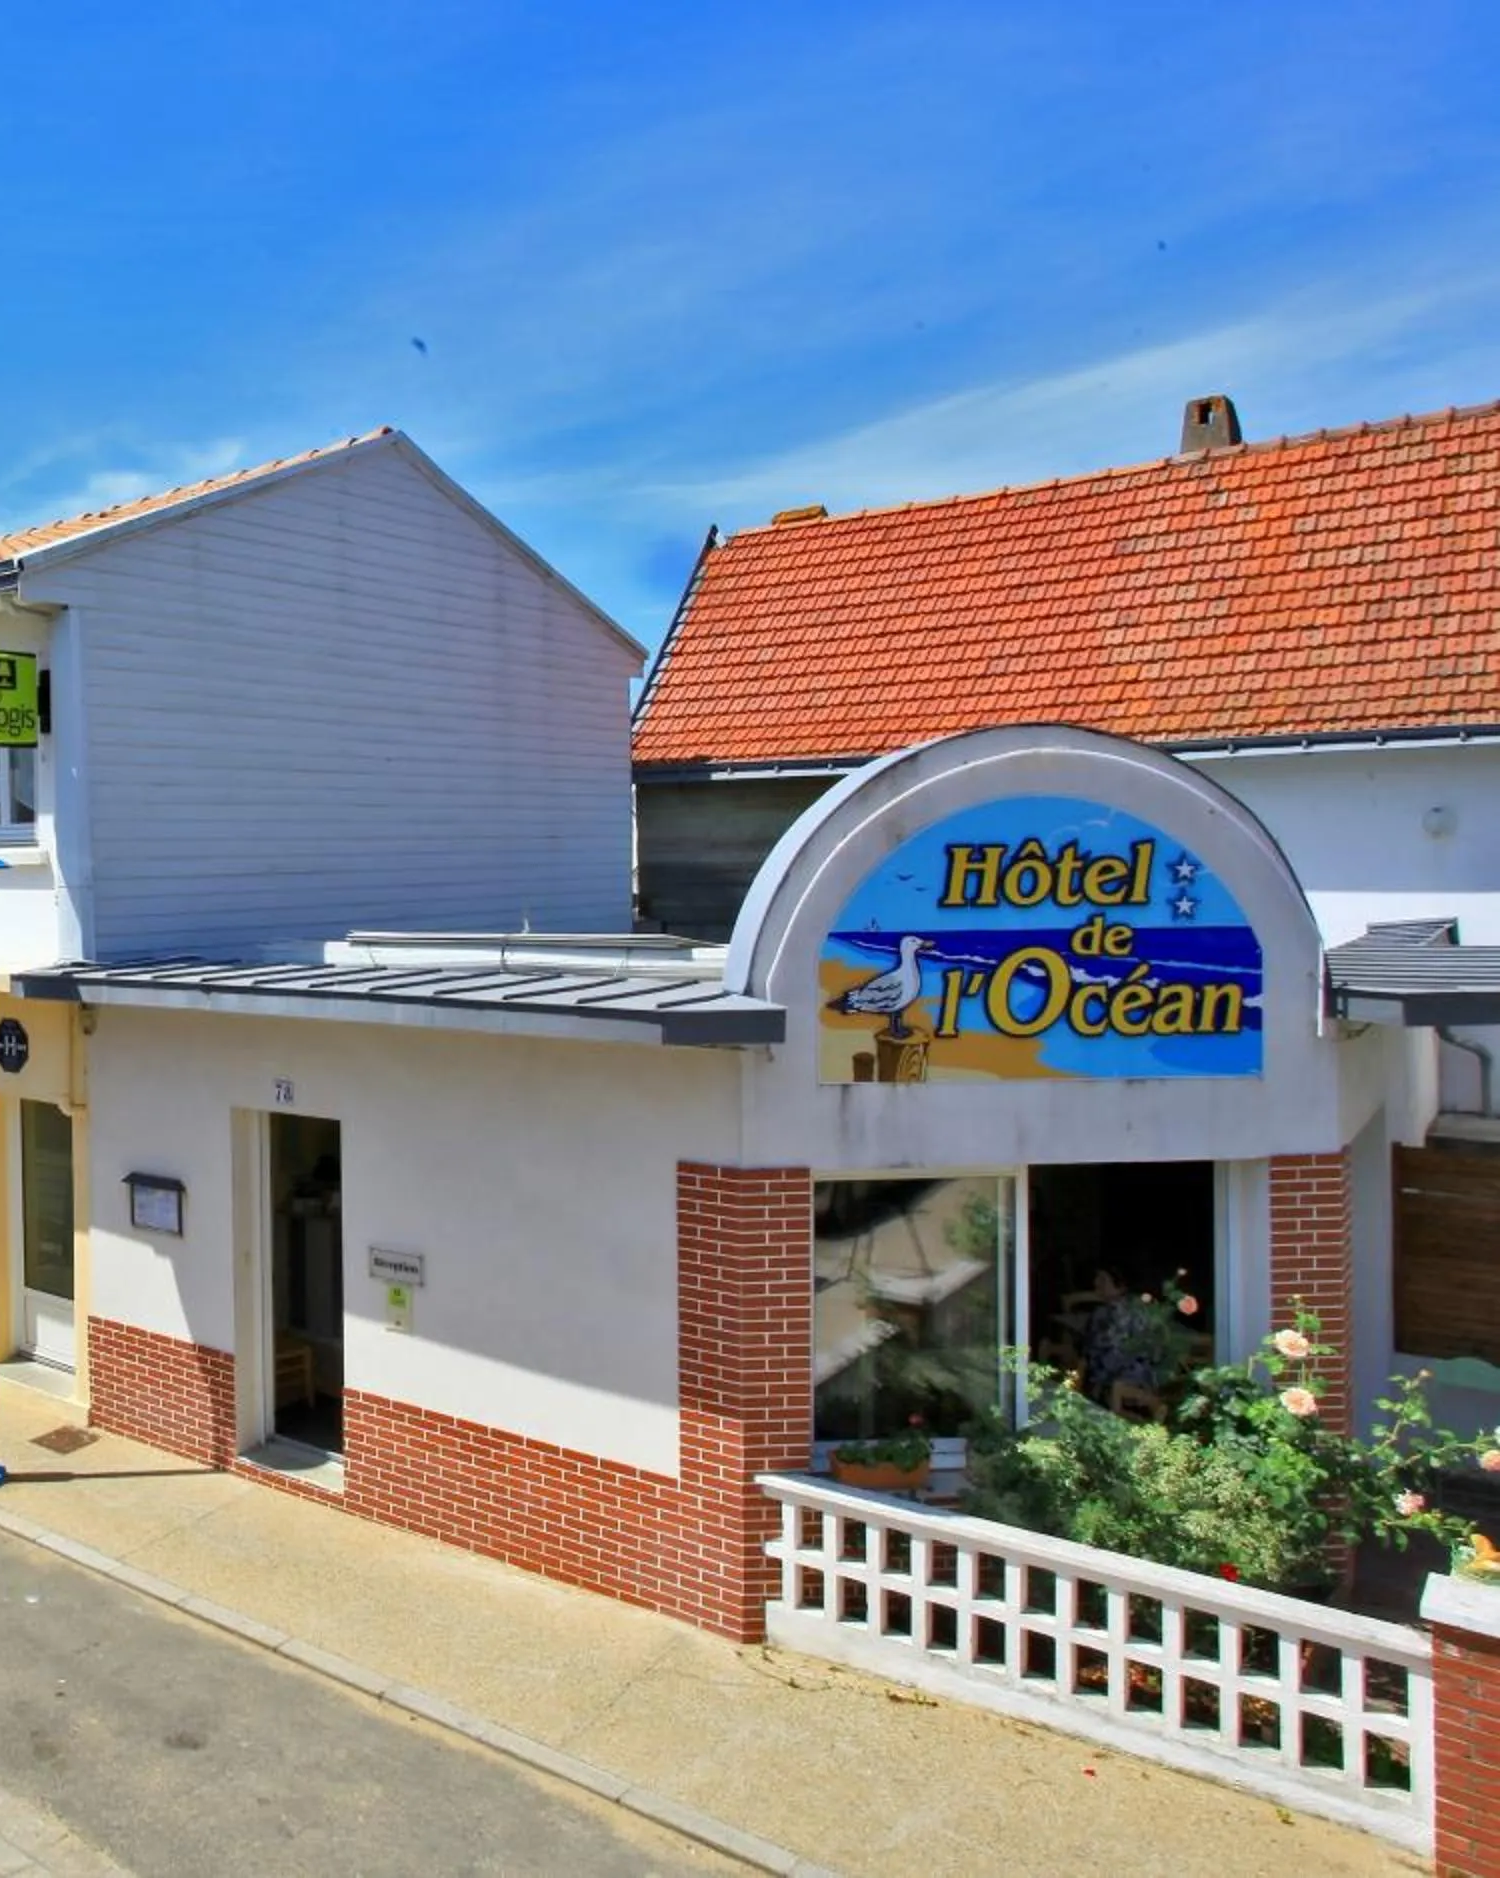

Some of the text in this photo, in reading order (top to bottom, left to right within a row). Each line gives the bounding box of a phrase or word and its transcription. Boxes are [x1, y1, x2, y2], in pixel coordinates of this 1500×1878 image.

[940, 839, 1155, 907] Hôtel
[1069, 914, 1134, 958] de
[937, 945, 1244, 1038] l'Océan
